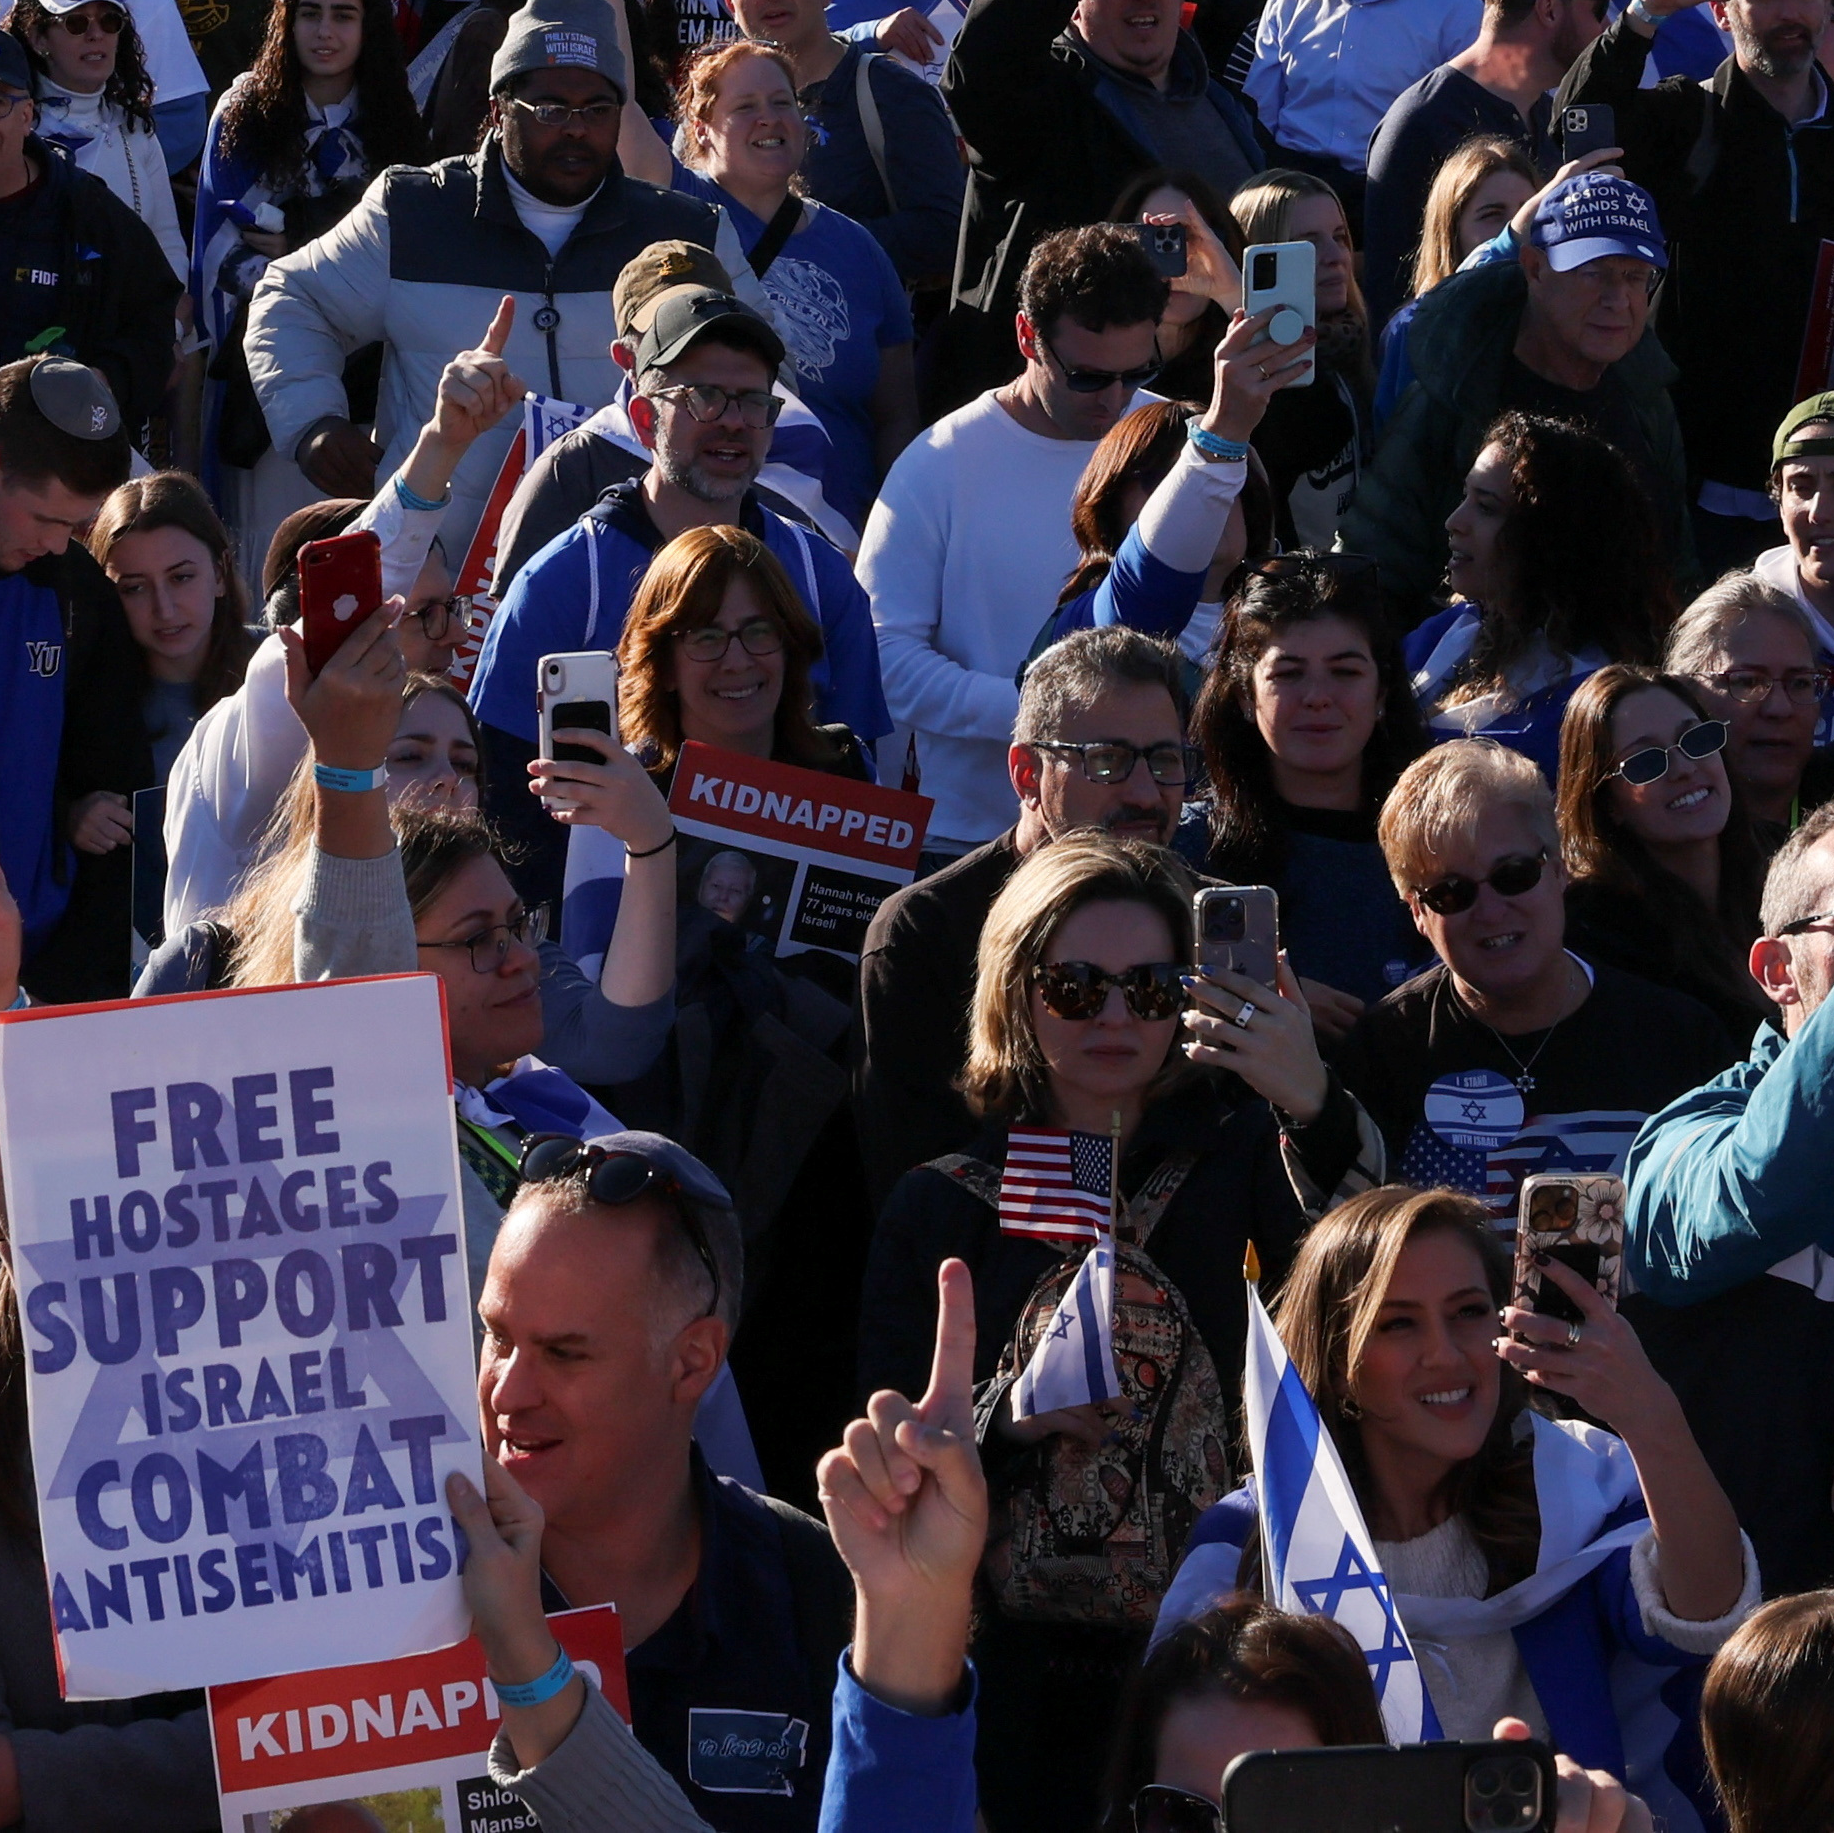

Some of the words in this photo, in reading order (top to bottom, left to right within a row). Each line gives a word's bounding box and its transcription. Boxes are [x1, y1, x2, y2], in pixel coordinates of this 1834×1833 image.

[544, 32, 570, 42] PHILLY
[545, 42, 568, 54] WITH
[569, 42, 597, 58] ISRAEL
[1563, 186, 1620, 207] BOSTON
[1564, 199, 1620, 219] STANDS
[1565, 215, 1601, 234] WITH
[1605, 215, 1651, 234] ISRAEL
[31, 269, 59, 286] FIDF
[25, 640, 62, 678] YU
[689, 772, 914, 850] KIDNAPPED
[805, 897, 820, 910] 77
[822, 903, 853, 920] years
[855, 907, 875, 921] old
[801, 913, 836, 930] Israeli
[1463, 1074, 1488, 1088] STAND
[111, 1067, 341, 1178] FREE
[1452, 1134, 1473, 1146] WITH
[1473, 1136, 1499, 1148] ISRAEL
[70, 1161, 400, 1260] HOSTAGES
[27, 1234, 457, 1375] SUPPORT
[141, 1347, 366, 1436] ISRAEL
[76, 1414, 446, 1551] COMBAT
[56, 1515, 467, 1634] ANTISEMITIS
[698, 1740, 717, 1757] חי
[719, 1734, 764, 1759] ישראל
[767, 1733, 789, 1759] עם
